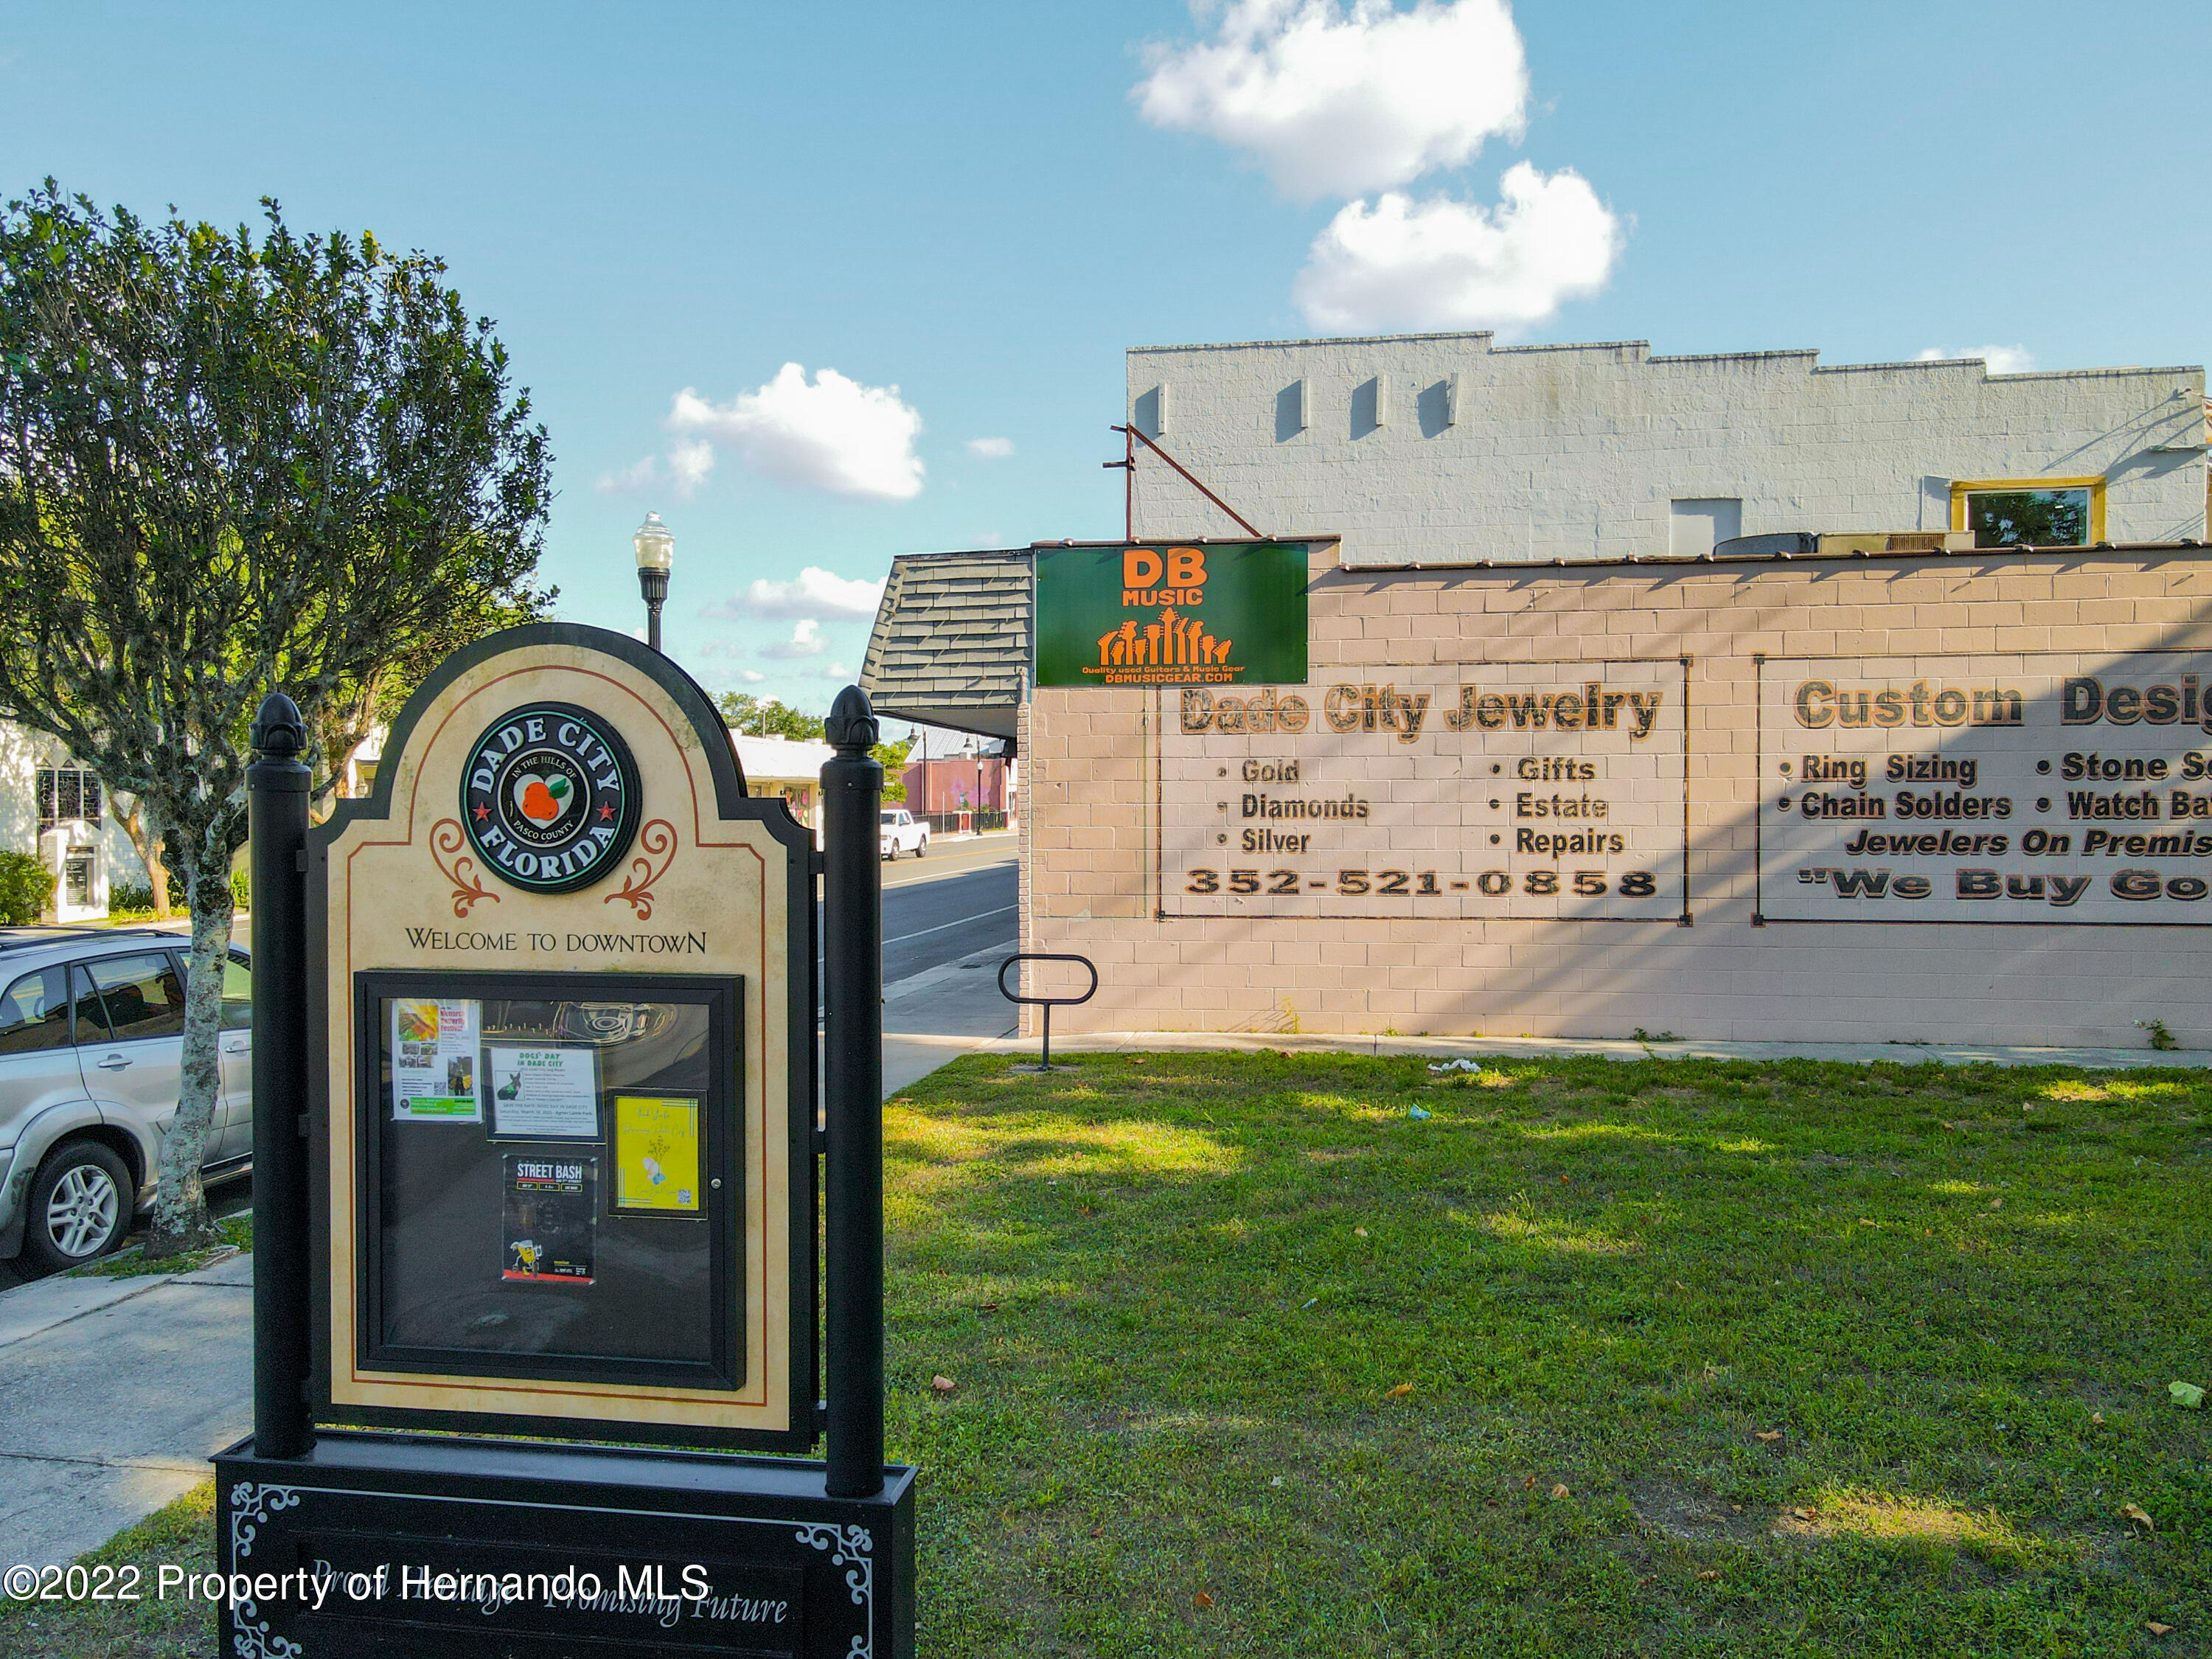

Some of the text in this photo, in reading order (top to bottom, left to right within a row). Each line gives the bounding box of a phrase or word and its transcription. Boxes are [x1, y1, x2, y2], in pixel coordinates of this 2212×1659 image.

[1122, 548, 1208, 589] DB
[1121, 589, 1204, 607] MUSIC
[1082, 667, 1116, 675] Quality
[1105, 672, 1233, 684] DBMUSICGEAR.COM
[1180, 683, 1663, 744] Dade City Jewelry
[1794, 673, 2212, 735] Custom Desi
[471, 717, 621, 793] DADE CITY
[512, 756, 577, 779] IN THE HILLS OF
[2061, 751, 2170, 780] Stone
[1241, 757, 1596, 784] Gold Gifts
[1801, 754, 1978, 789] Ring Sizing
[1241, 793, 1609, 821] Diamonds Estate
[1801, 790, 2012, 819] Chain Solders
[2066, 790, 2212, 819] Watch Ba
[513, 820, 574, 840] PASCO COUNTY
[1241, 828, 1625, 860] Silver Repairs
[1846, 829, 2008, 855] Jewelers
[2021, 829, 2070, 855] On
[480, 825, 616, 879] FLORIDA
[1186, 869, 1658, 897] 352-521-0858
[1955, 868, 2092, 906] Buy
[405, 928, 706, 955] WELCOME TO DOWNTOWN
[517, 1163, 582, 1180] STREET BASH
[543, 1575, 683, 1628] Promising
[690, 1585, 787, 1623] Future
